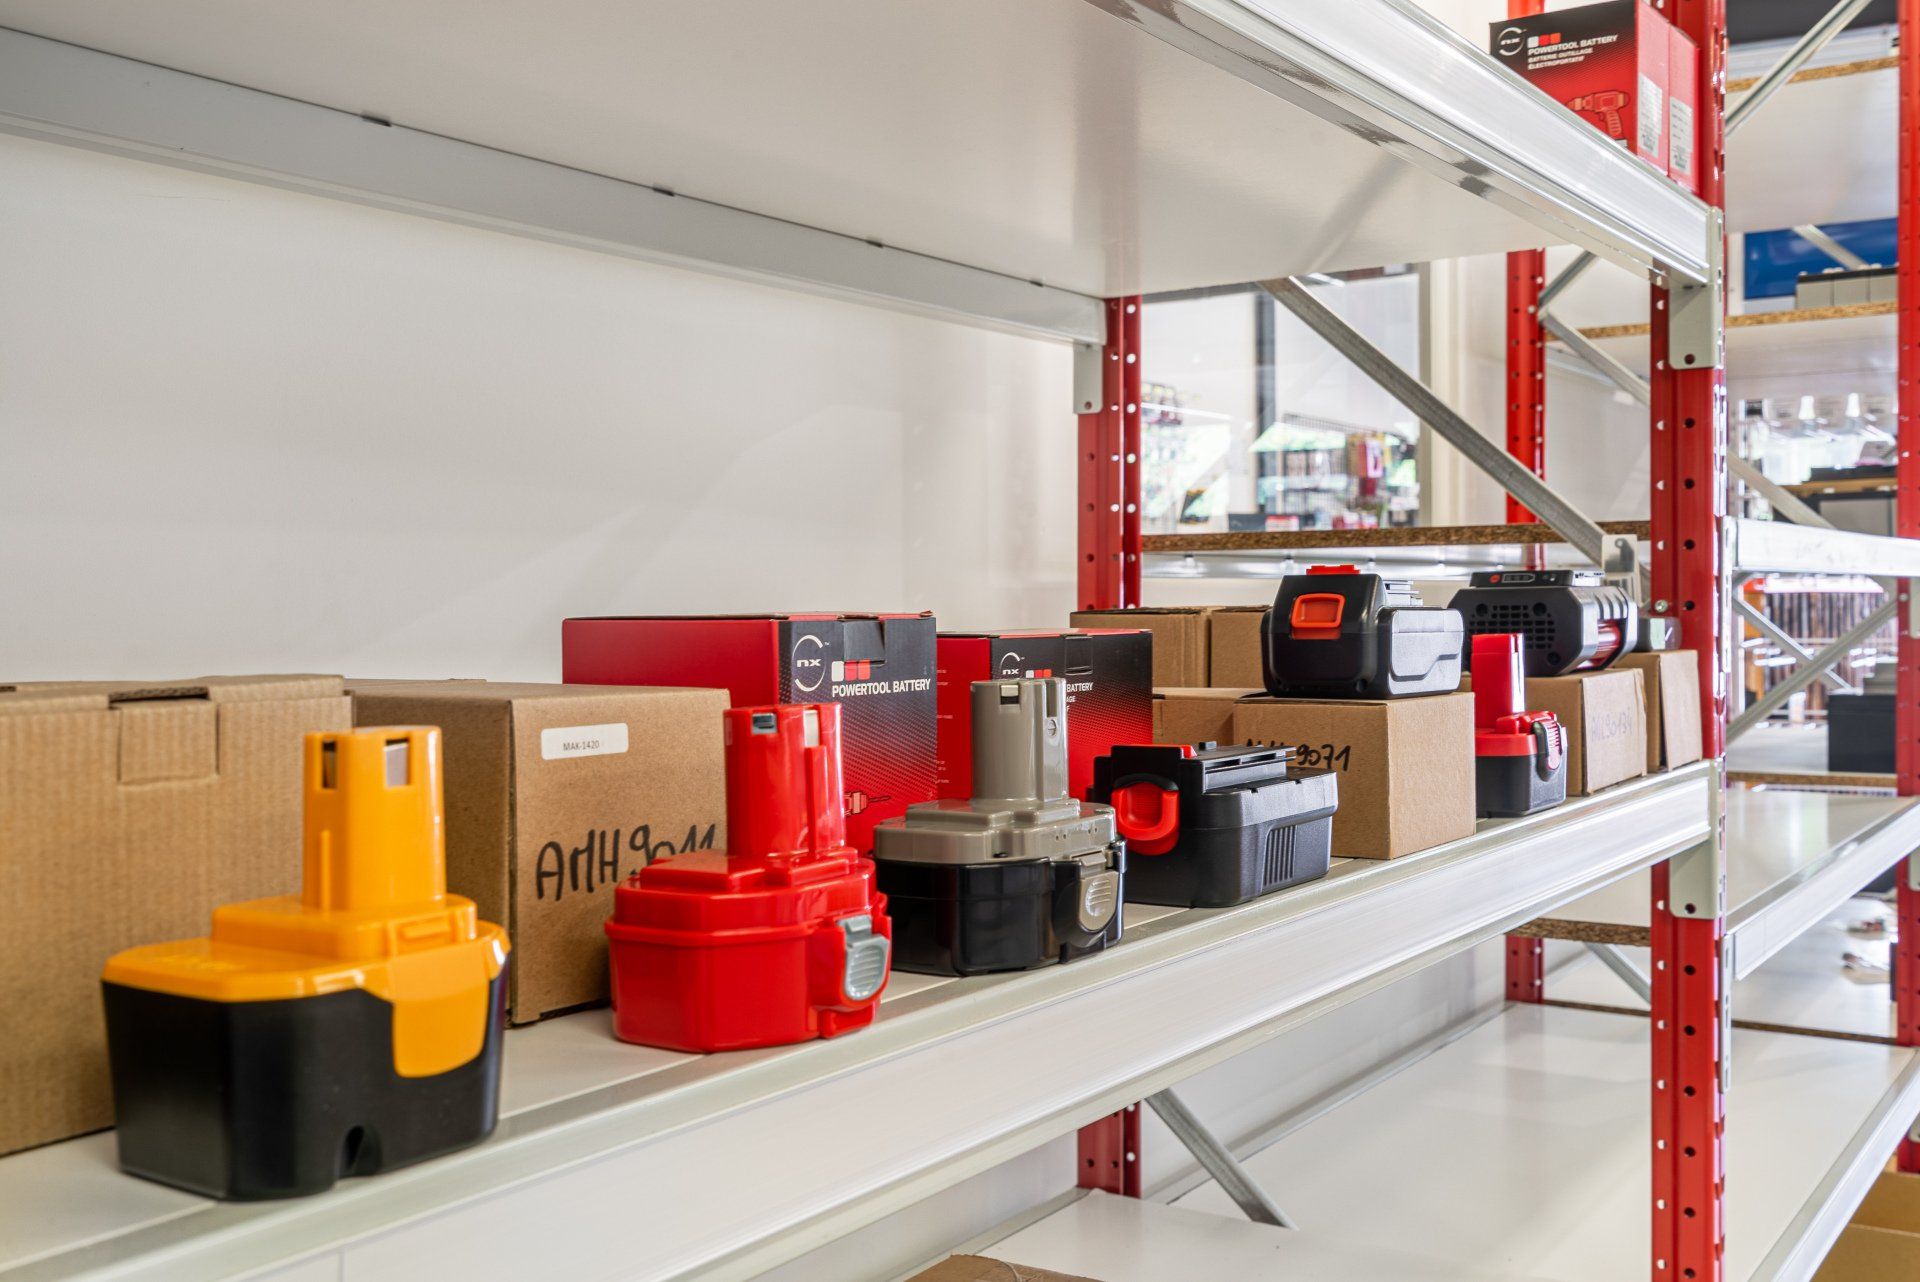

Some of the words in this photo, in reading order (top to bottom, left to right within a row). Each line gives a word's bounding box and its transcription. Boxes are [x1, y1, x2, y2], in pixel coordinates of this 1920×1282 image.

[1528, 41, 1579, 56] POWERTOOL
[1580, 34, 1618, 48] BATTERY
[831, 682, 891, 698] POWERTOOL
[893, 678, 931, 693] BATTERY
[1066, 682, 1093, 693] BATTERY
[562, 740, 600, 751] MAK-1420
